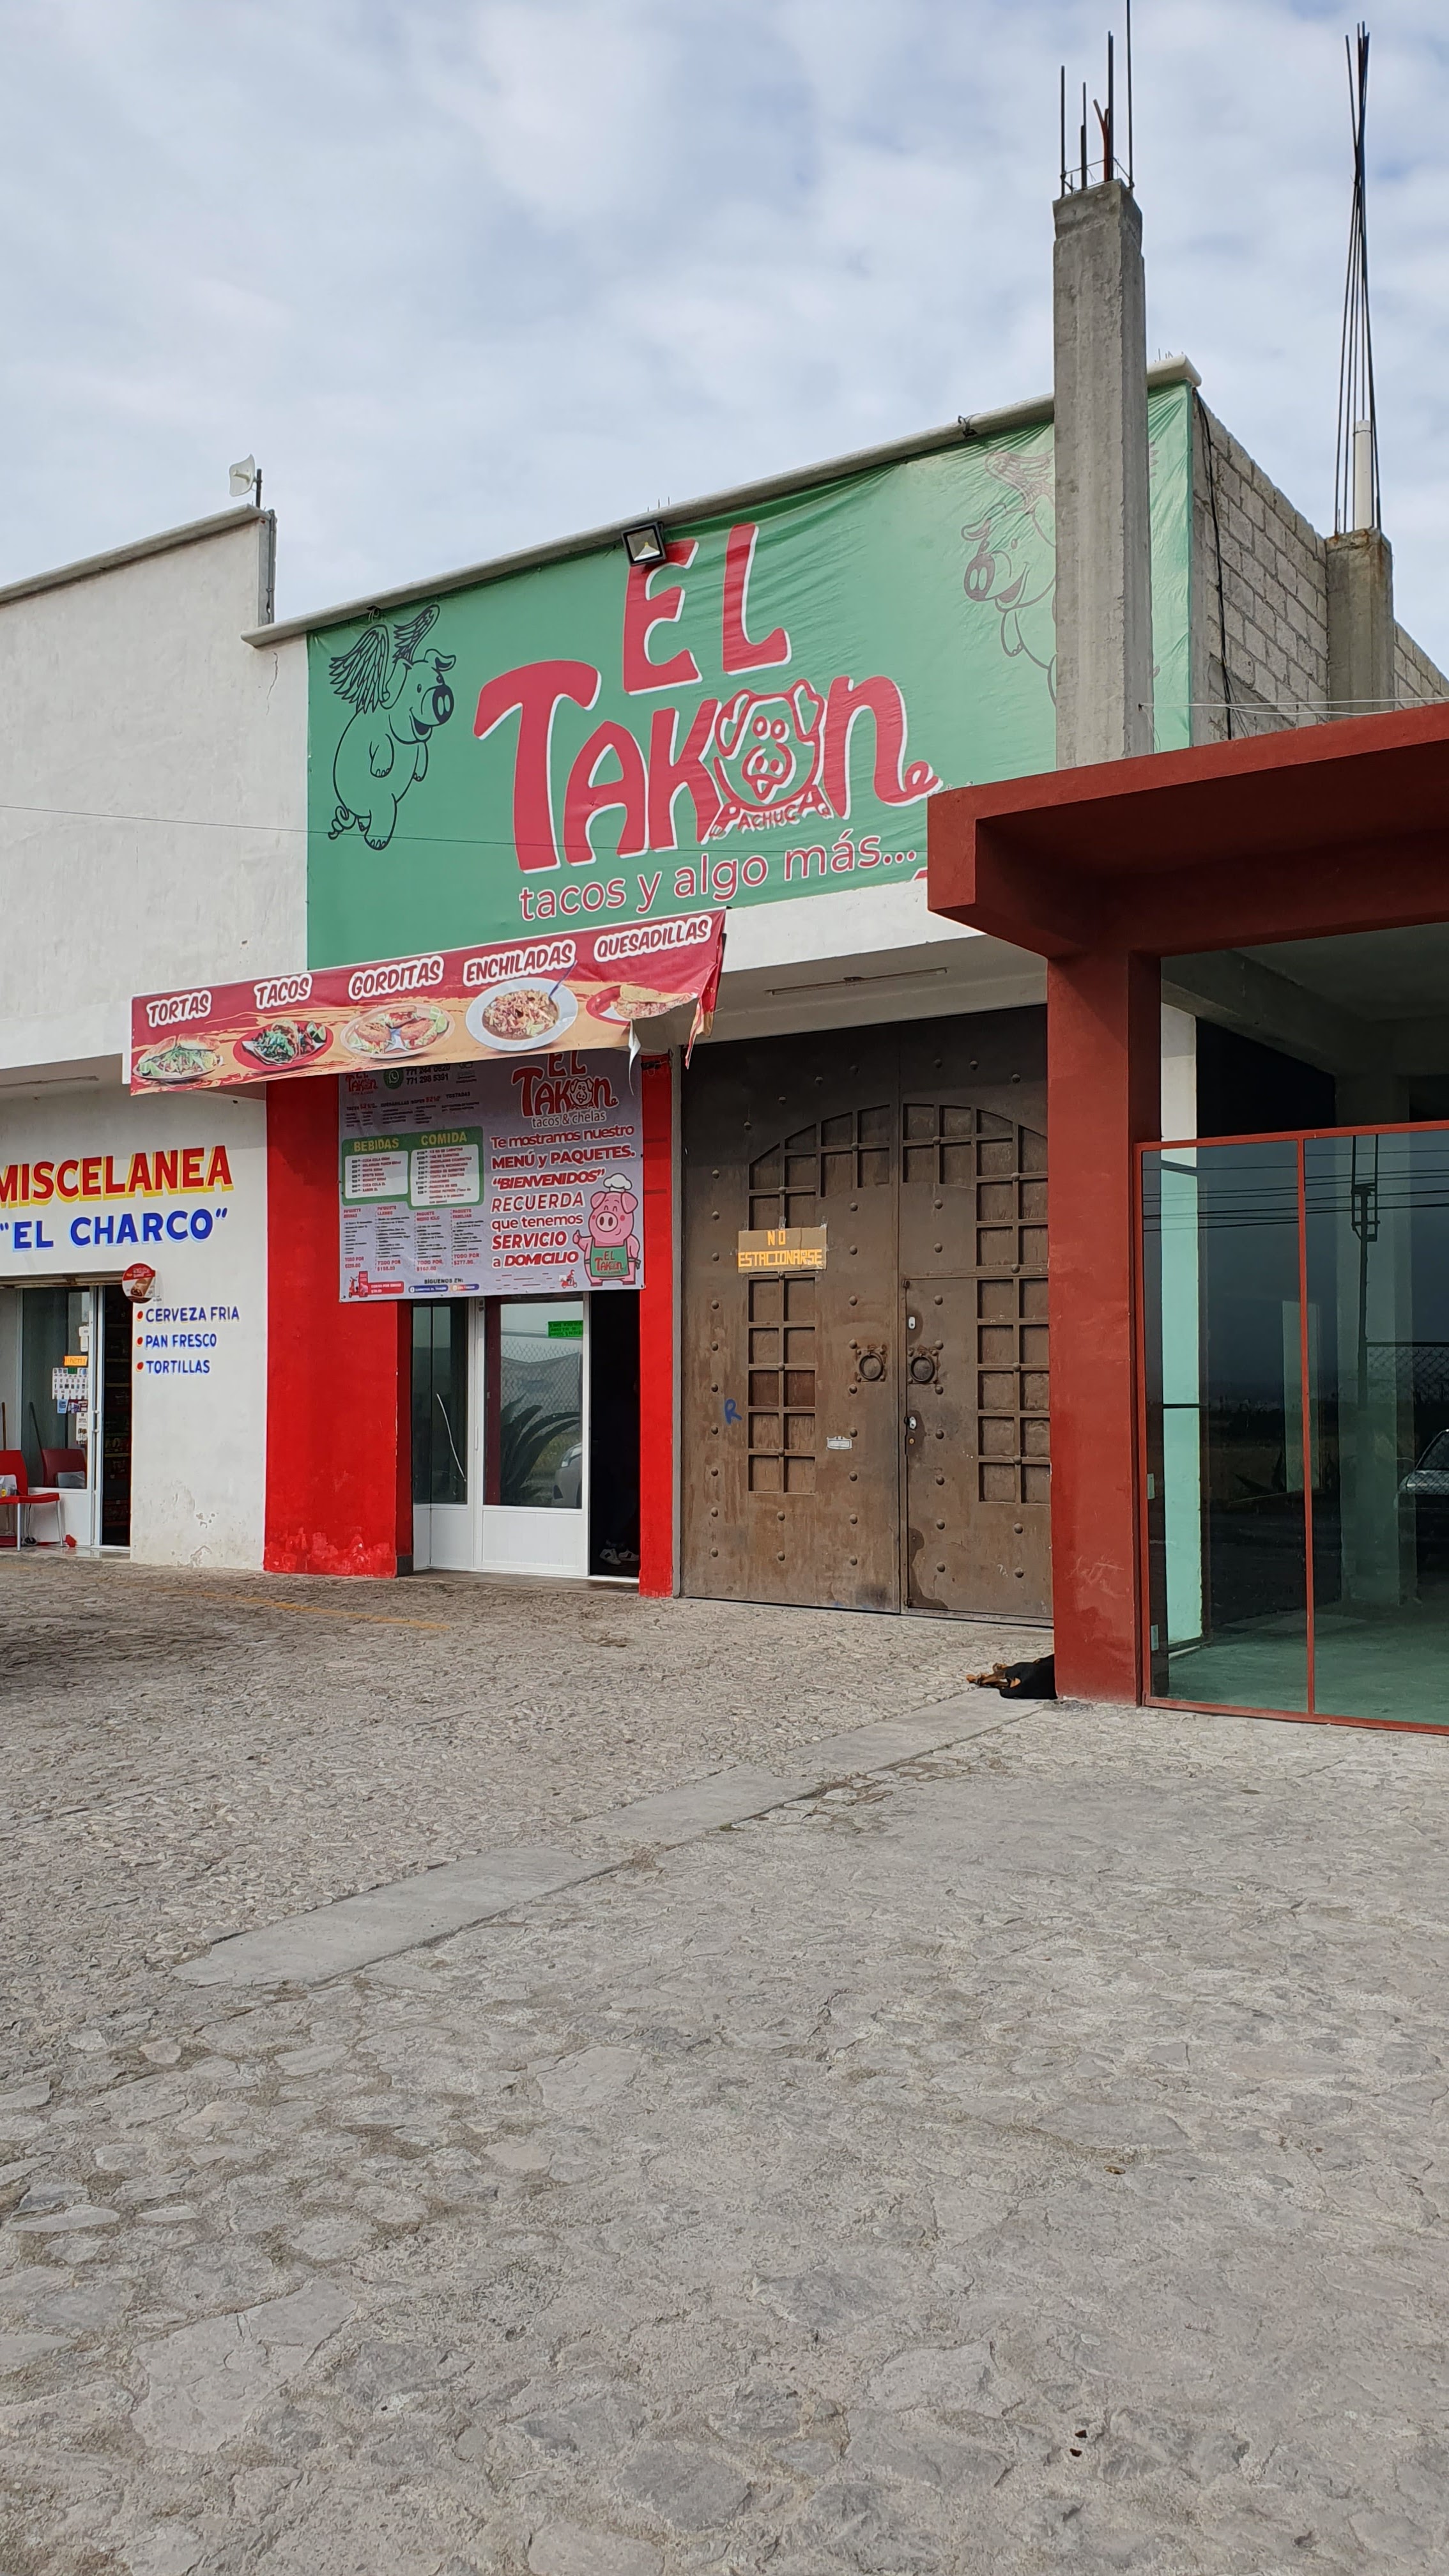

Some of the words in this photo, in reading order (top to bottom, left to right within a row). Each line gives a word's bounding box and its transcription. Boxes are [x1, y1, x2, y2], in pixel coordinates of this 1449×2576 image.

[622, 522, 792, 694] EL
[709, 785, 832, 839] PACHUCA
[519, 877, 627, 921] tacos
[635, 871, 663, 914] y
[673, 852, 769, 901] algo
[783, 829, 918, 882] más...
[148, 993, 211, 1026] TORTAS
[256, 976, 312, 1008] TACOS
[350, 959, 442, 999] GORDITAS
[465, 942, 574, 984] ENCHILADAS
[595, 918, 709, 959] QUESADILLAS
[548, 1051, 587, 1077] EL
[532, 1117, 560, 1128] tacos
[562, 1115, 570, 1125] &
[572, 1110, 606, 1124] chelas
[354, 1138, 399, 1153] BEBIDAS
[420, 1131, 467, 1146] COMIDA
[491, 1137, 506, 1149] Te
[509, 1130, 580, 1147] mostramos
[584, 1125, 634, 1140] nuestro
[492, 1151, 535, 1170] MENÚ
[539, 1156, 548, 1168] y
[550, 1145, 635, 1165] PAQUETES.
[0, 1145, 233, 1207] MISCELANEA
[491, 1192, 583, 1213] RECUERDA
[492, 1218, 519, 1232] que
[521, 1214, 583, 1228] tenemos
[491, 1230, 567, 1250] SERVICIO
[767, 1230, 786, 1246] NO
[493, 1257, 501, 1268] a
[505, 1251, 579, 1267] DOMICILIO
[737, 1248, 824, 1268] ESTACIONARSE
[146, 1307, 206, 1322] CERVEZA
[210, 1305, 240, 1321] FRIA
[145, 1334, 168, 1348] PAN
[172, 1333, 217, 1347] FRESCO
[146, 1360, 210, 1374] TORTILLAS
